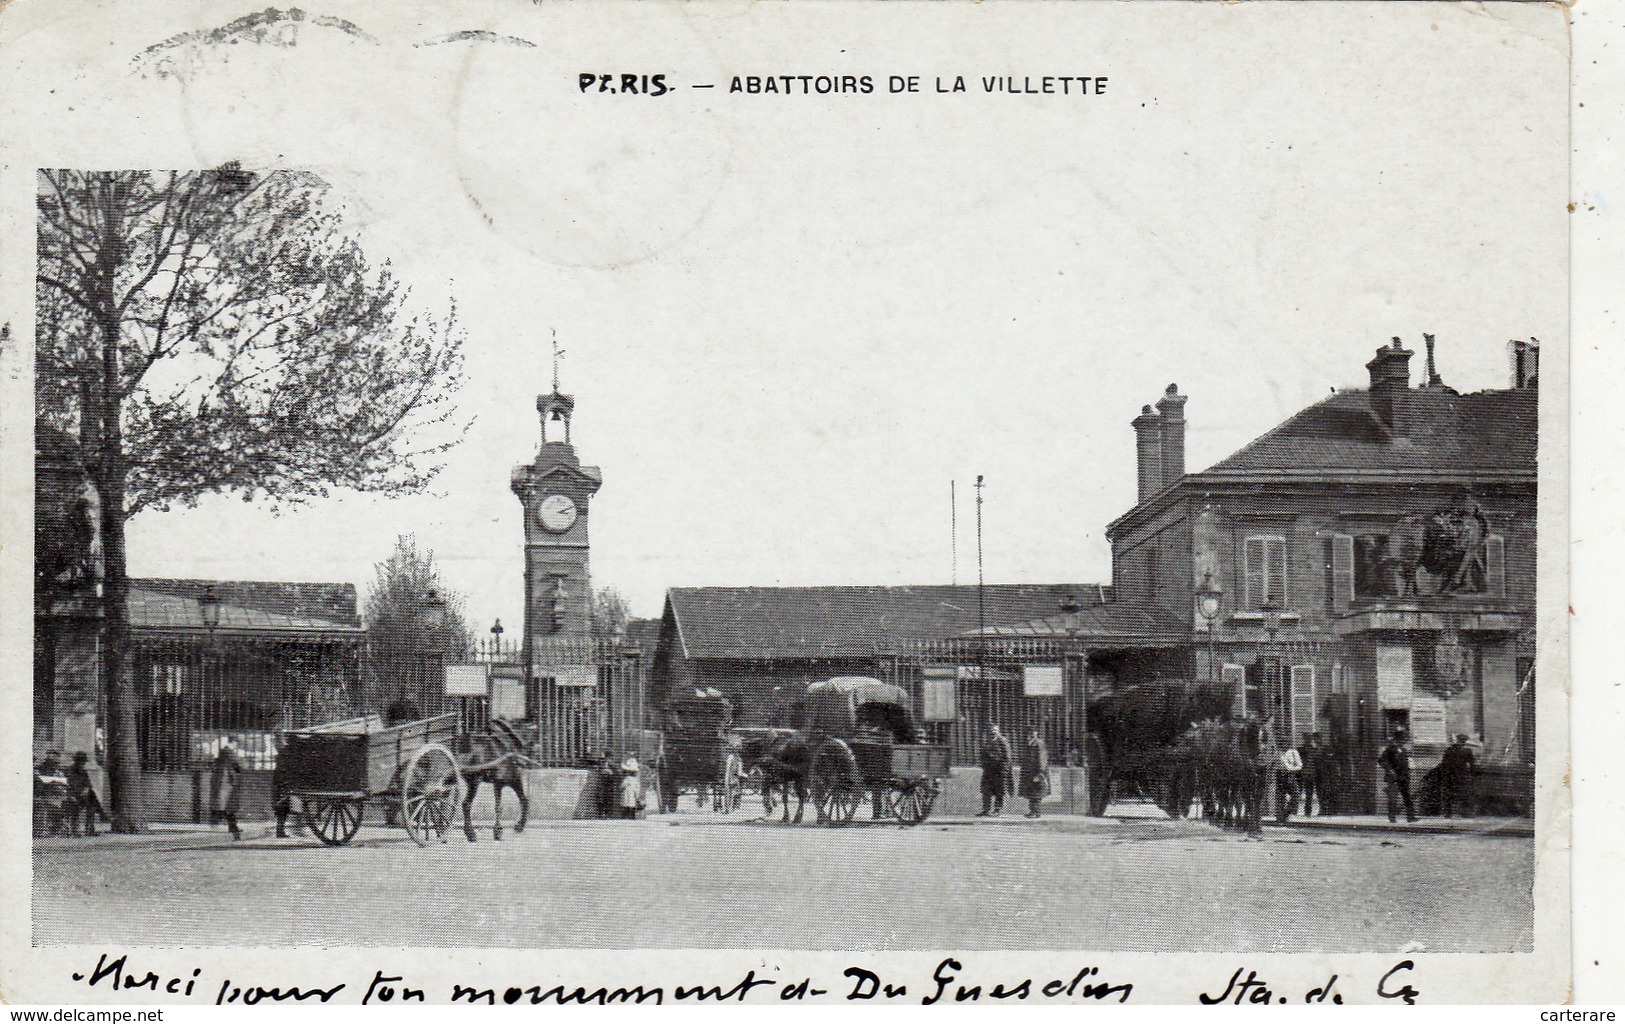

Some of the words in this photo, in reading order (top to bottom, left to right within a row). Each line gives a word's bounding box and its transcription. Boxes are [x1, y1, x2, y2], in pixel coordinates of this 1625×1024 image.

[729, 76, 874, 95] ABATTOIRS
[890, 76, 920, 94] DE
[936, 76, 966, 93] LA
[983, 76, 1109, 95] VILLETTE
